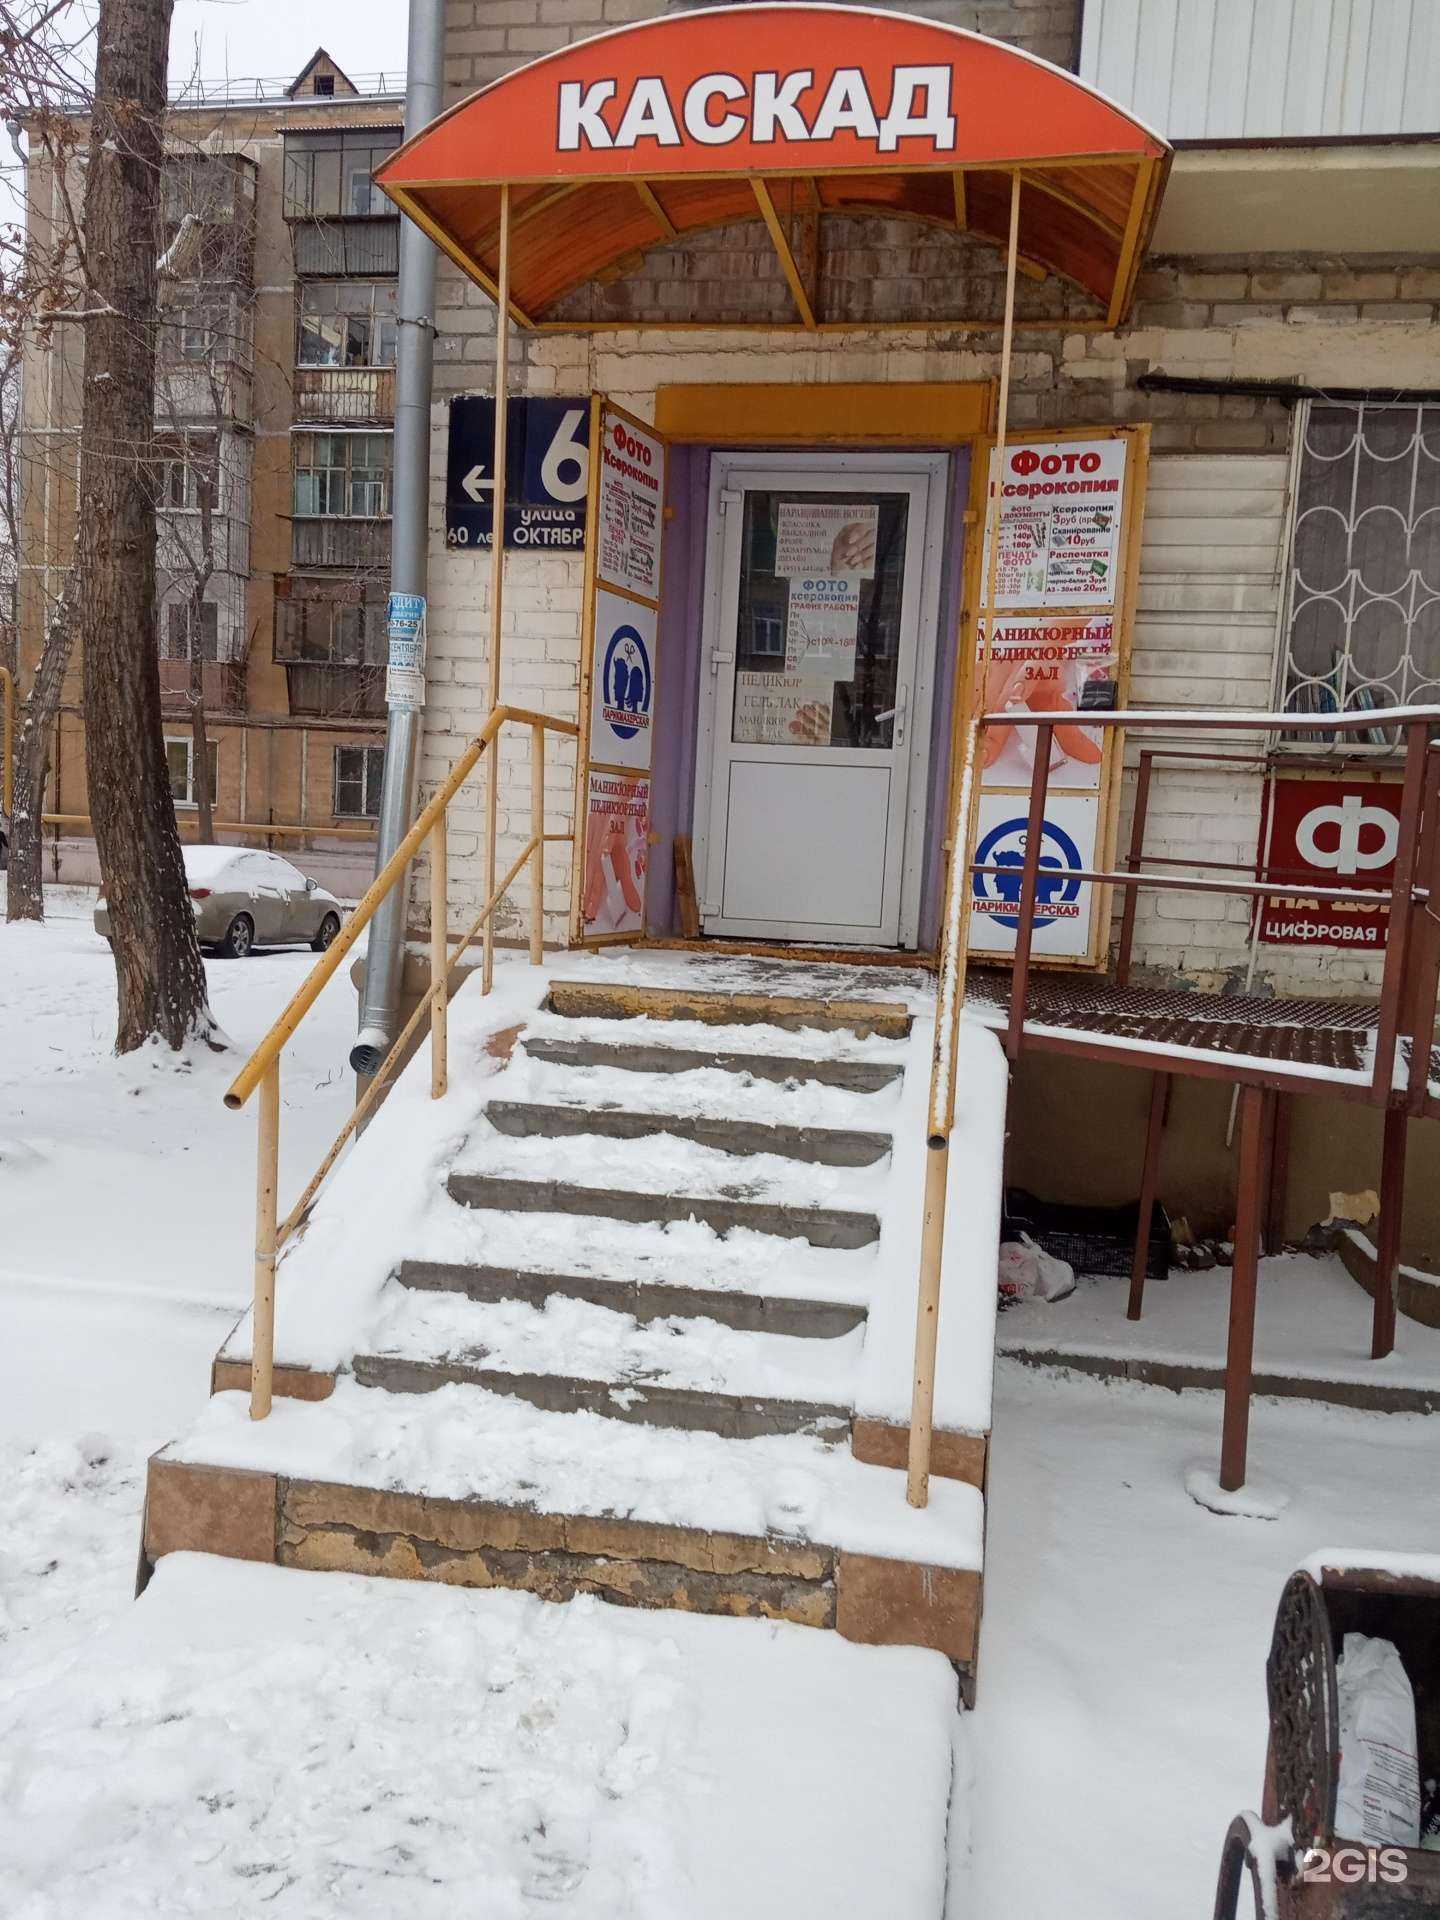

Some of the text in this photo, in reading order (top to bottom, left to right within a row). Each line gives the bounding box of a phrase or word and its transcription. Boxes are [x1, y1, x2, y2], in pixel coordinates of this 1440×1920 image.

[557, 63, 957, 153] КАСКАД
[541, 410, 589, 502] 6
[604, 447, 659, 492] Ксерокопия
[1052, 505, 1114, 514] Ксерокопия
[521, 509, 576, 526] улица
[1053, 514, 1077, 525] 3руб
[447, 527, 587, 545] 60 ле ОКТЯБР
[1052, 526, 1111, 535] Сканирование
[1066, 535, 1096, 546] 10руб
[1049, 550, 1109, 559] Распечатка
[823, 603, 858, 611] РАБОТЫ
[1025, 667, 1059, 681] ЗАЛ
[602, 707, 650, 727] ПАРИКМАХЕРСКАЯ
[610, 820, 625, 835] ЗАЛ
[972, 901, 1080, 916] ПАРИКМЕРСКАЯ
[1265, 920, 1377, 942] ЦИФРОВАЯ
